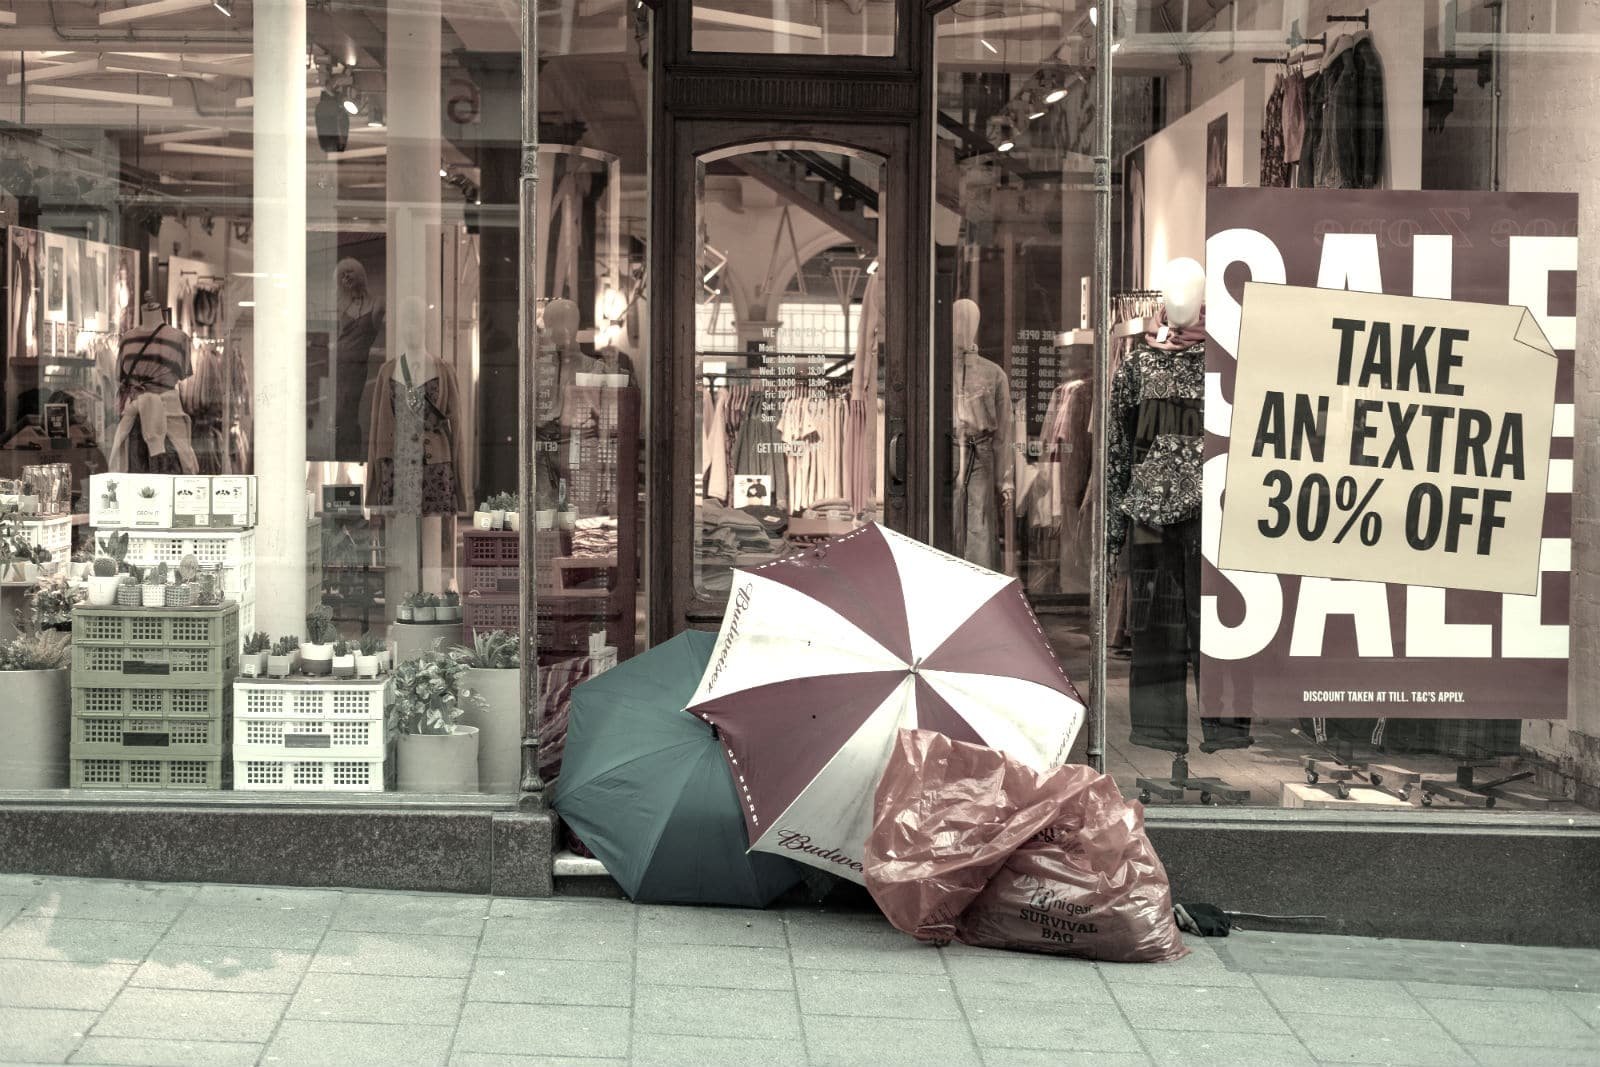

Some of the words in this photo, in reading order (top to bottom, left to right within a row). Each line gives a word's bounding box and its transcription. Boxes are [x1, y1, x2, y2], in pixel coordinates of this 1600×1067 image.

[763, 328, 775, 337] WE
[1331, 318, 1470, 397] TAKE
[757, 442, 771, 453] GET
[1251, 390, 1330, 463] AN
[1349, 398, 1526, 481] EXTRA
[1256, 469, 1384, 547] 30%
[1404, 482, 1512, 556] OFF
[706, 582, 753, 694] Budweiser
[1303, 690, 1346, 702] DISCOUNT
[1348, 690, 1374, 702] TAKEN
[1376, 691, 1386, 702] AT
[1389, 691, 1409, 702] TILL.
[1438, 691, 1465, 703] APPLY.
[1019, 908, 1099, 933] SURVIVAL
[1041, 927, 1074, 944] BAG
